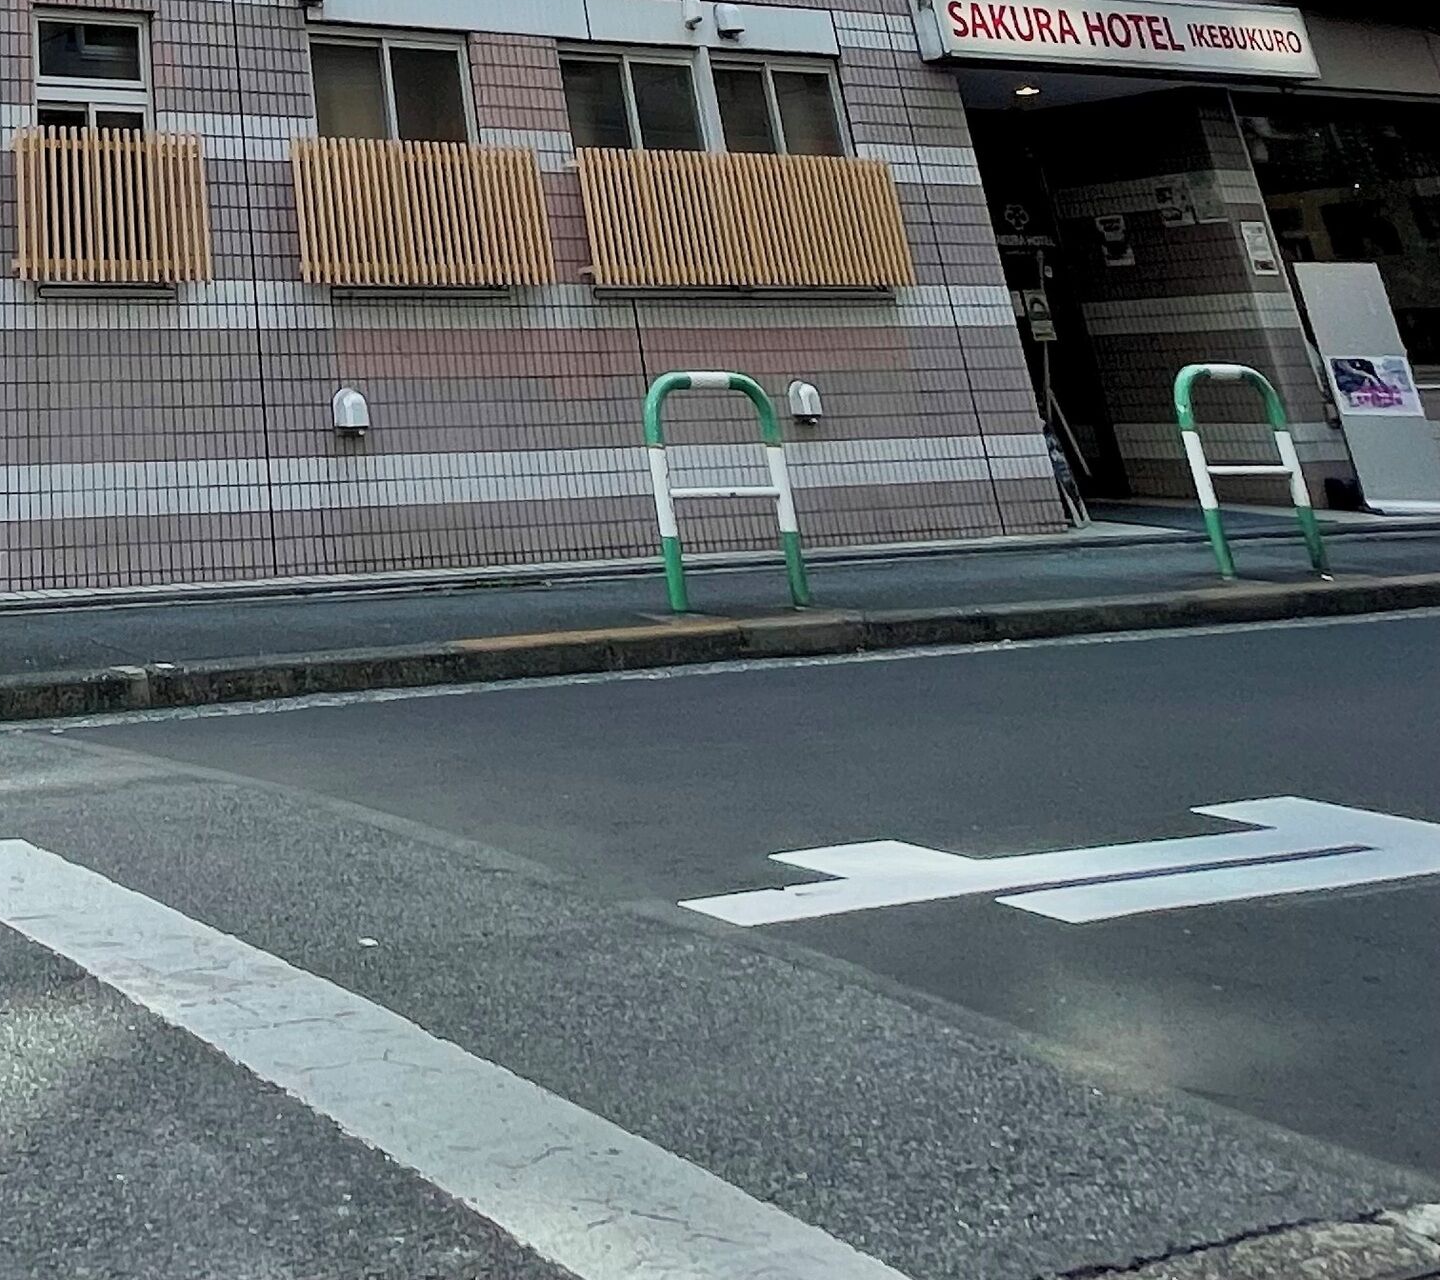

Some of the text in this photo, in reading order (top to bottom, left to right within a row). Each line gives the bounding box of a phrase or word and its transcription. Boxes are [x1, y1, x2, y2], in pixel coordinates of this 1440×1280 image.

[947, 0, 1302, 54] SAKURA HOTEL IKEBUKURO
